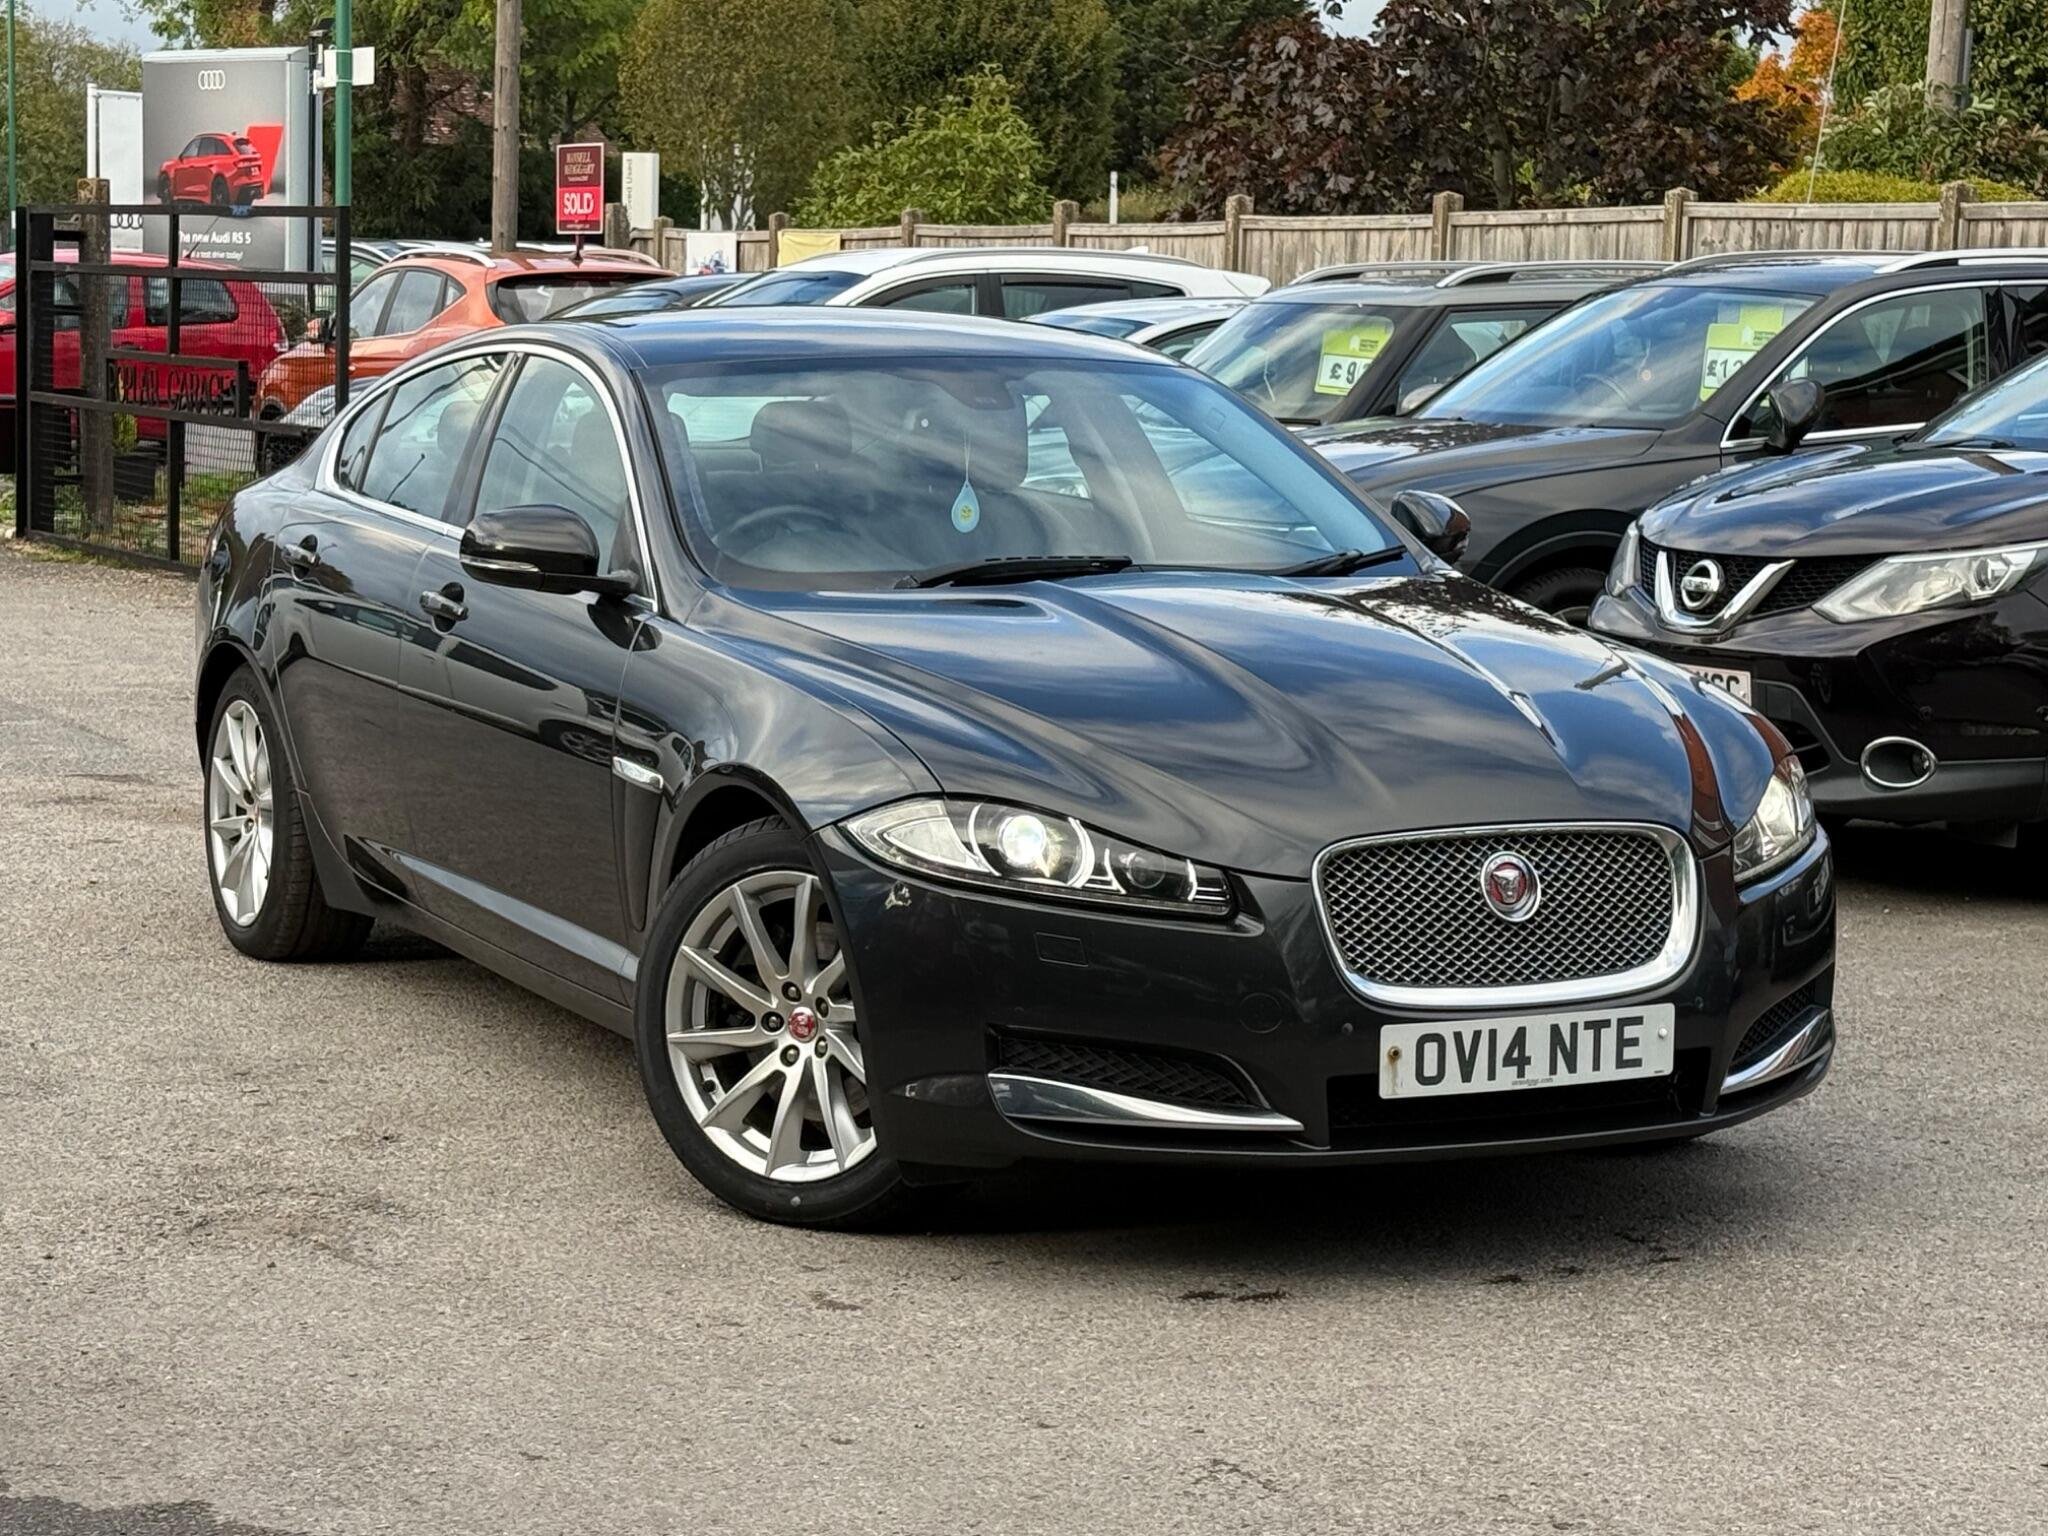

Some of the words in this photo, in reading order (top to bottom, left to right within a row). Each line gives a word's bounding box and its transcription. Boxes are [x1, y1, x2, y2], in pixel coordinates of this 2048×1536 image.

[564, 193, 594, 214] SOLD
[191, 233, 209, 243] new
[210, 231, 230, 243] Audi
[232, 232, 244, 244] RS
[245, 232, 252, 244] 5
[1415, 1026, 1531, 1086] OV14
[1550, 1015, 1644, 1076] NTE
